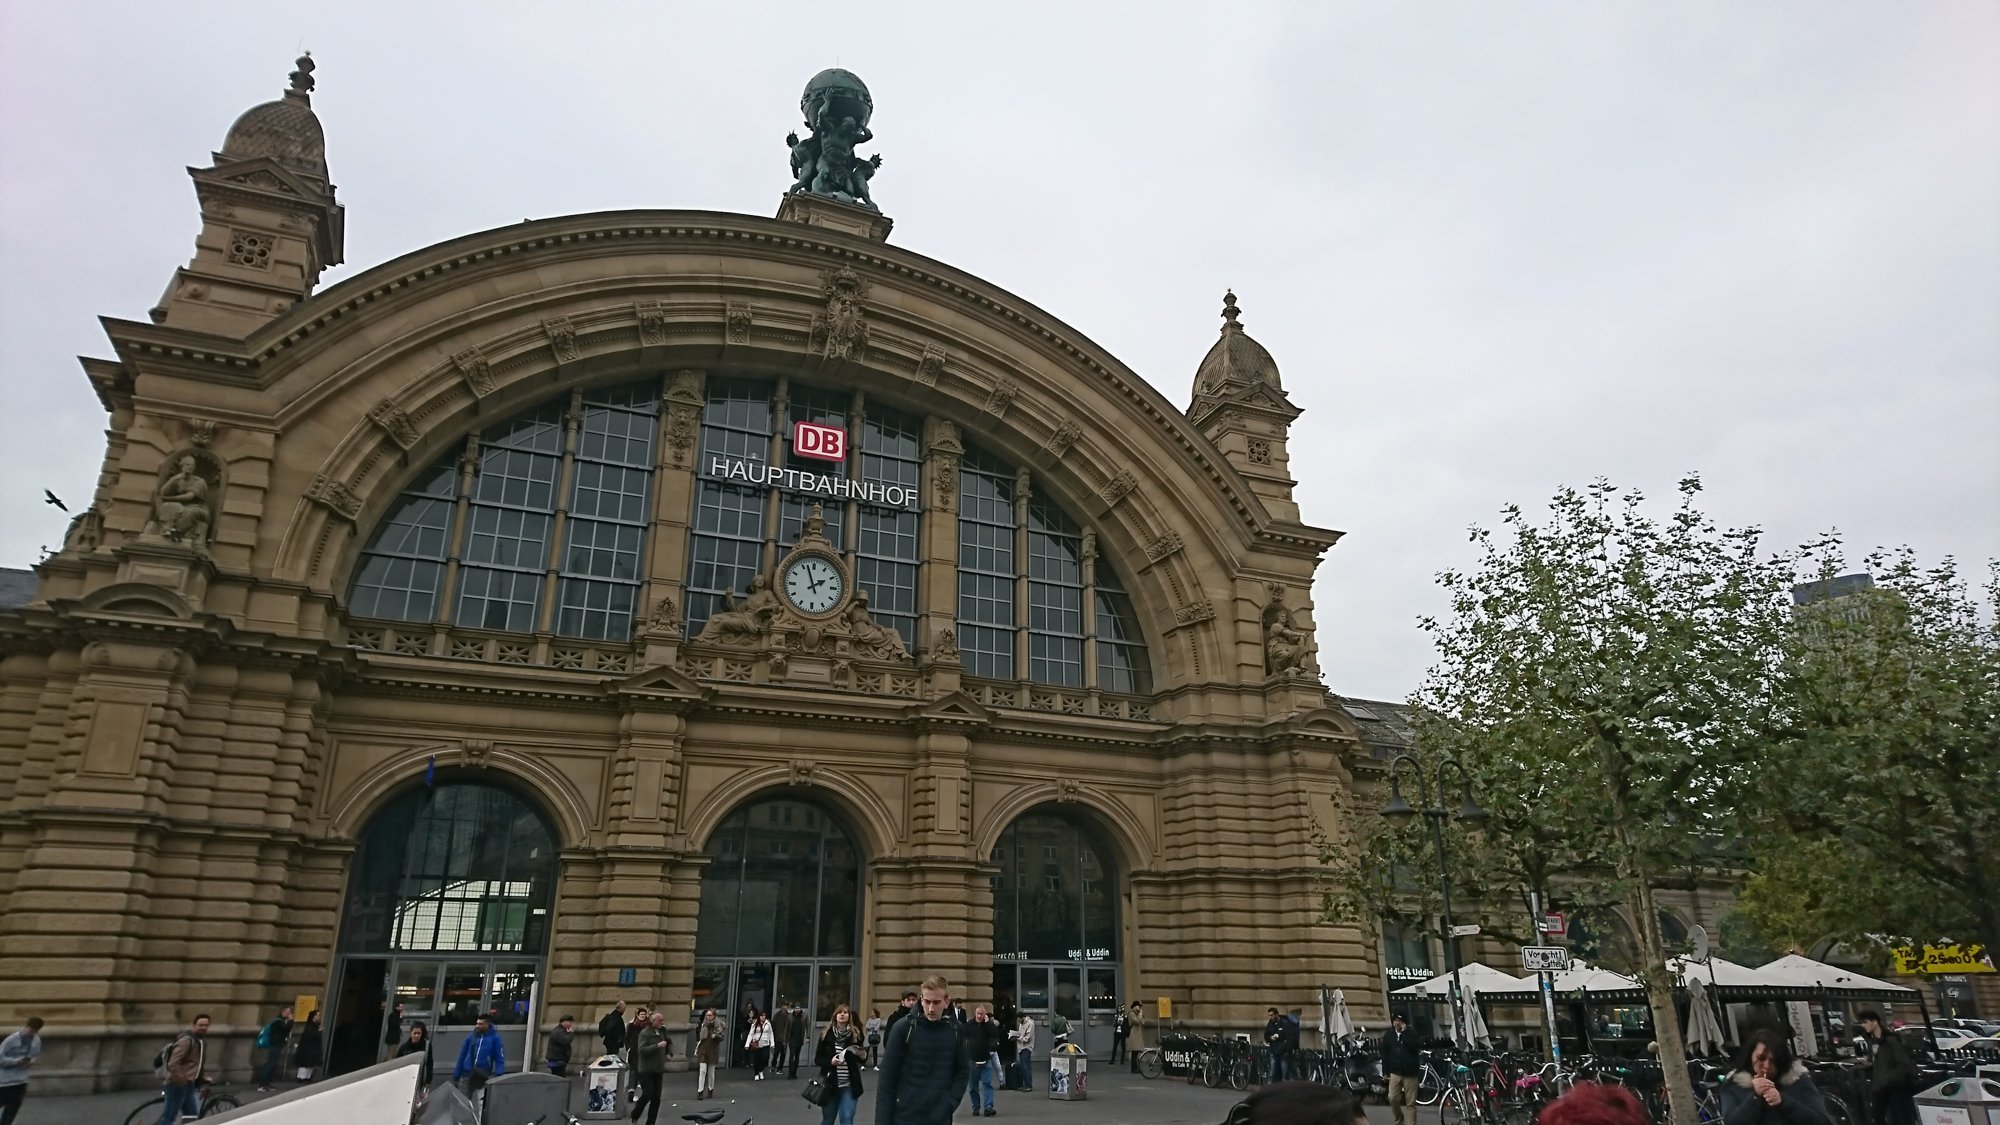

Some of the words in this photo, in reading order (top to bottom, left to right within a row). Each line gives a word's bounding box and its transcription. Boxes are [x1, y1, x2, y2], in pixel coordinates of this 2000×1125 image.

[802, 428, 840, 454] DB
[711, 456, 918, 507] HAUPTBAHNHOF
[1068, 949, 1082, 958] Uddi
[1091, 947, 1110, 957] Uddin
[1405, 966, 1412, 976] &
[1412, 968, 1434, 977] Uddin
[1164, 1050, 1184, 1063] Uddin
[1184, 1051, 1191, 1063] &
